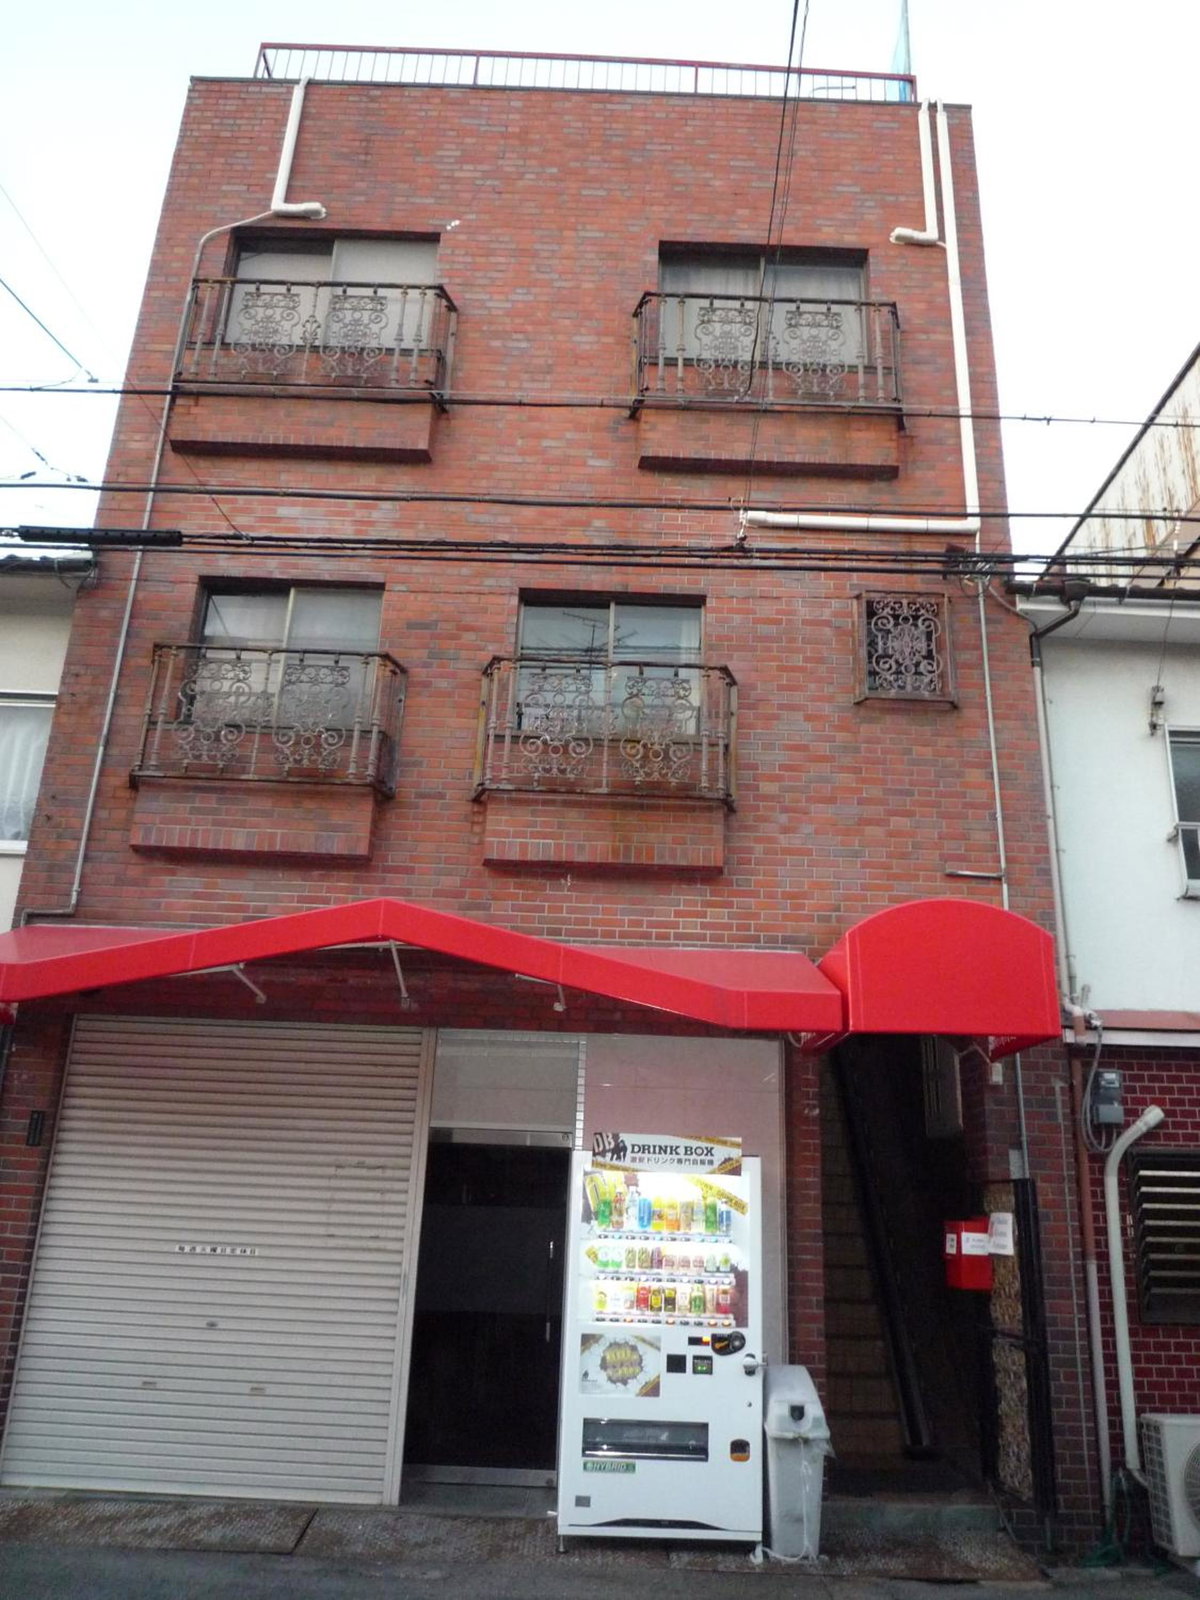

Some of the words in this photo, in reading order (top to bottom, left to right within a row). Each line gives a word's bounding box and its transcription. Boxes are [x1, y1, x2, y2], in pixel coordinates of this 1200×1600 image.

[593, 1132, 615, 1153] DB
[630, 1143, 681, 1156] DRINK
[684, 1146, 715, 1157] BOX
[593, 1461, 627, 1473] HYBRID
